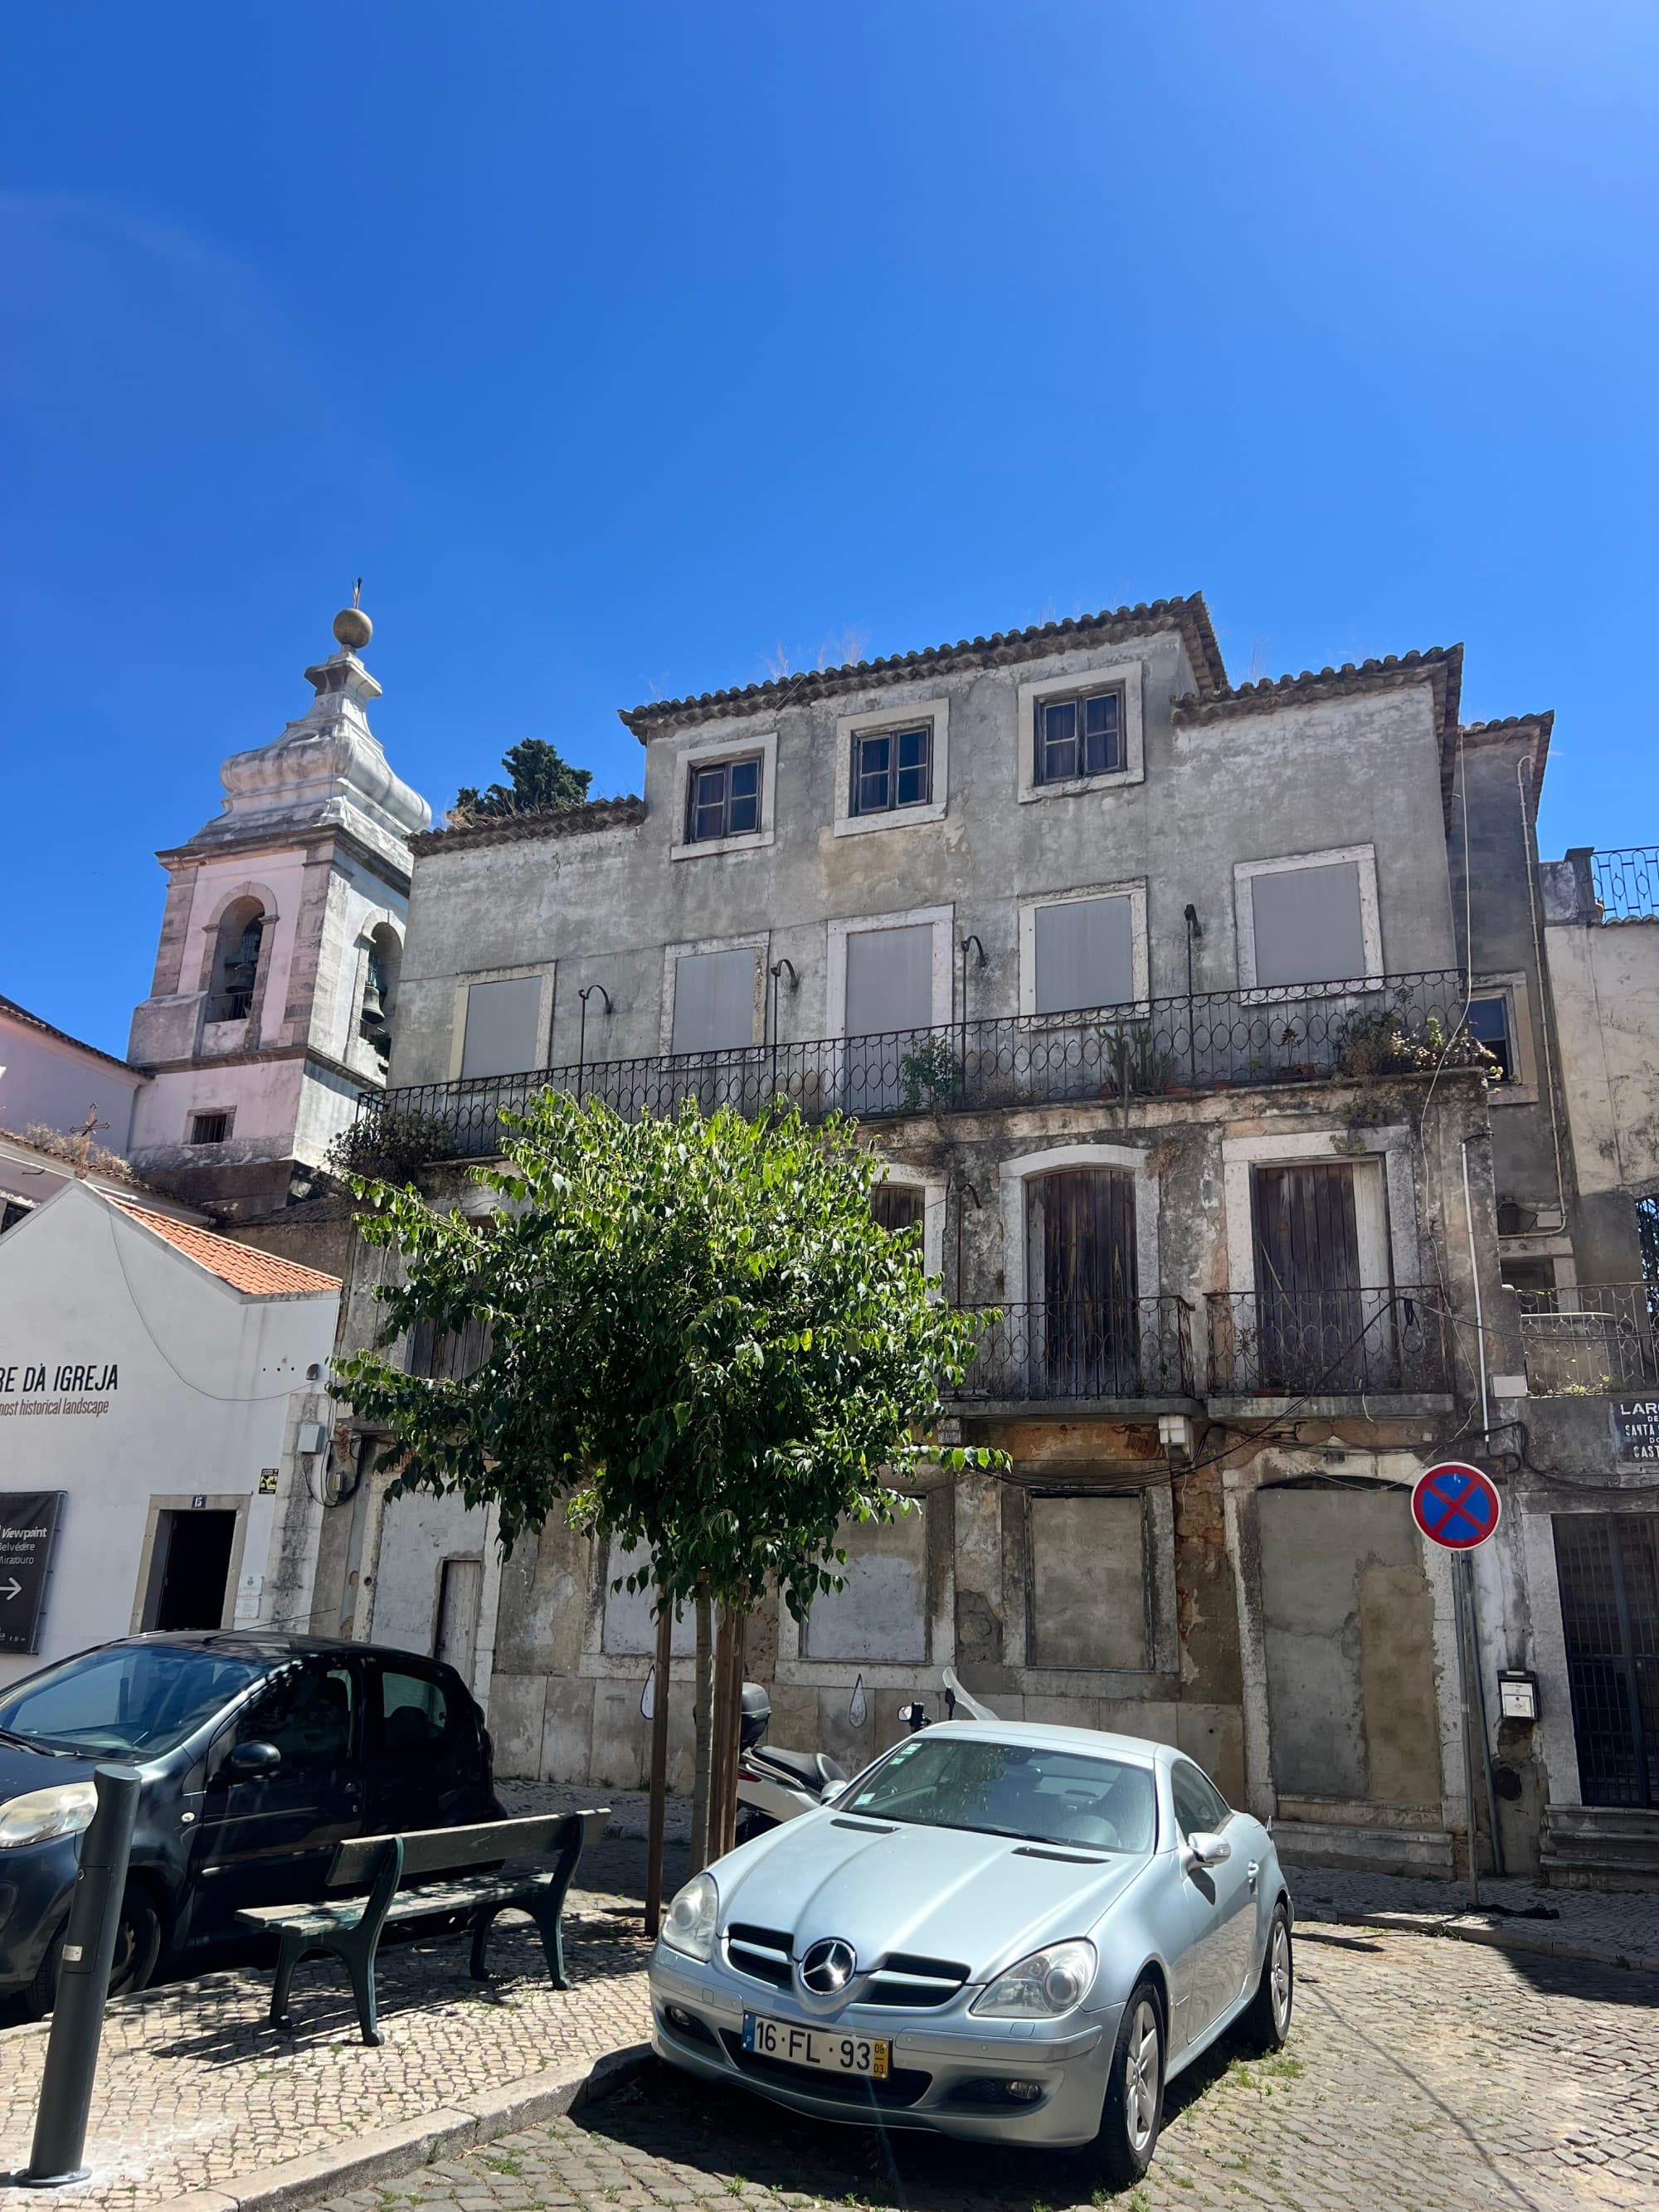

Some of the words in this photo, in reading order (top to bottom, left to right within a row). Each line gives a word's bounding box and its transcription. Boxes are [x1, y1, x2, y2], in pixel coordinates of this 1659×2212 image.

[53, 1364, 118, 1392] IGREJA
[19, 1397, 62, 1416] historical
[62, 1397, 109, 1417] landscape
[1620, 1403, 1659, 1415] LAR
[1625, 1424, 1655, 1436] SANTA
[195, 1496, 202, 1507] 15
[873, 2063, 884, 2074] 03
